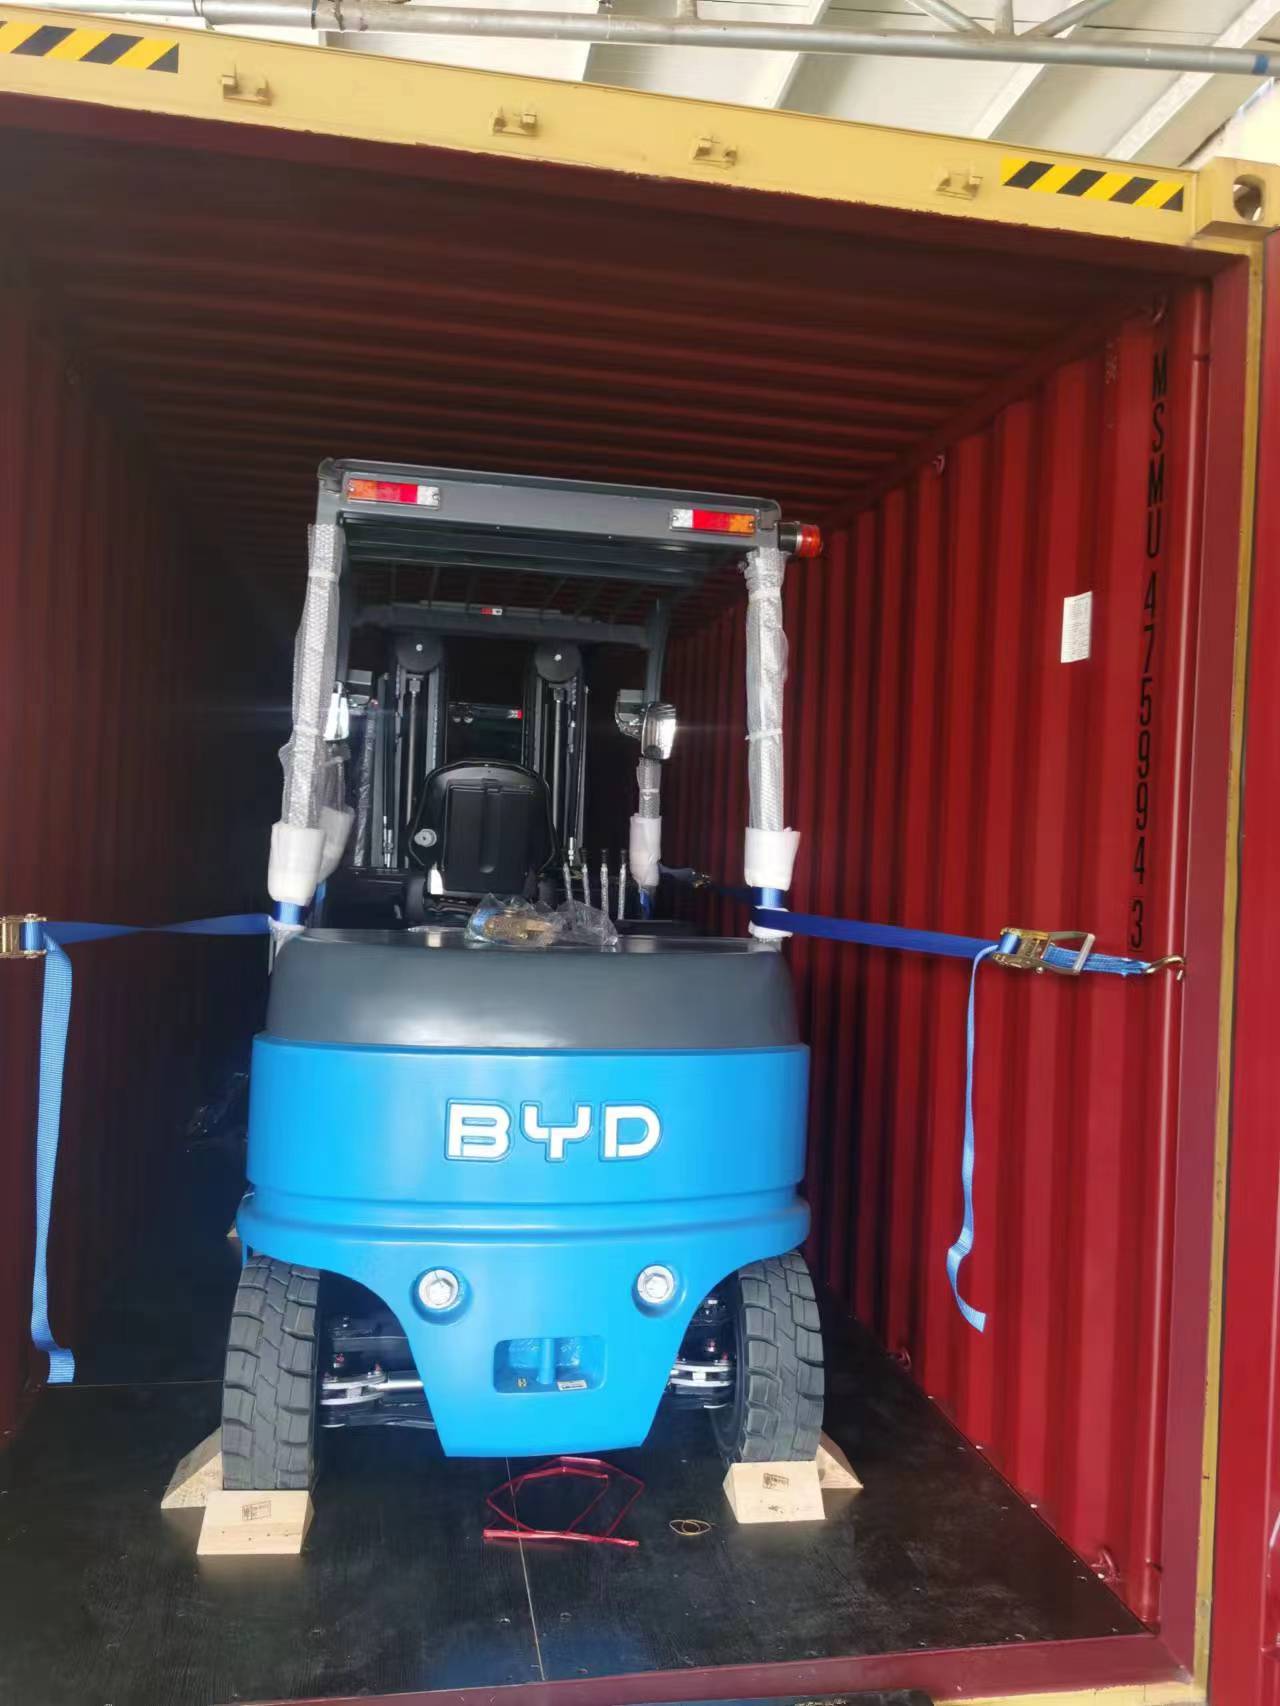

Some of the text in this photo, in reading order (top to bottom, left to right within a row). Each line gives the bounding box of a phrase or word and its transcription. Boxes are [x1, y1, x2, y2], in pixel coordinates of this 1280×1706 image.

[1130, 348, 1168, 949] MSMU 475994 3
[445, 1099, 662, 1162] BYD
